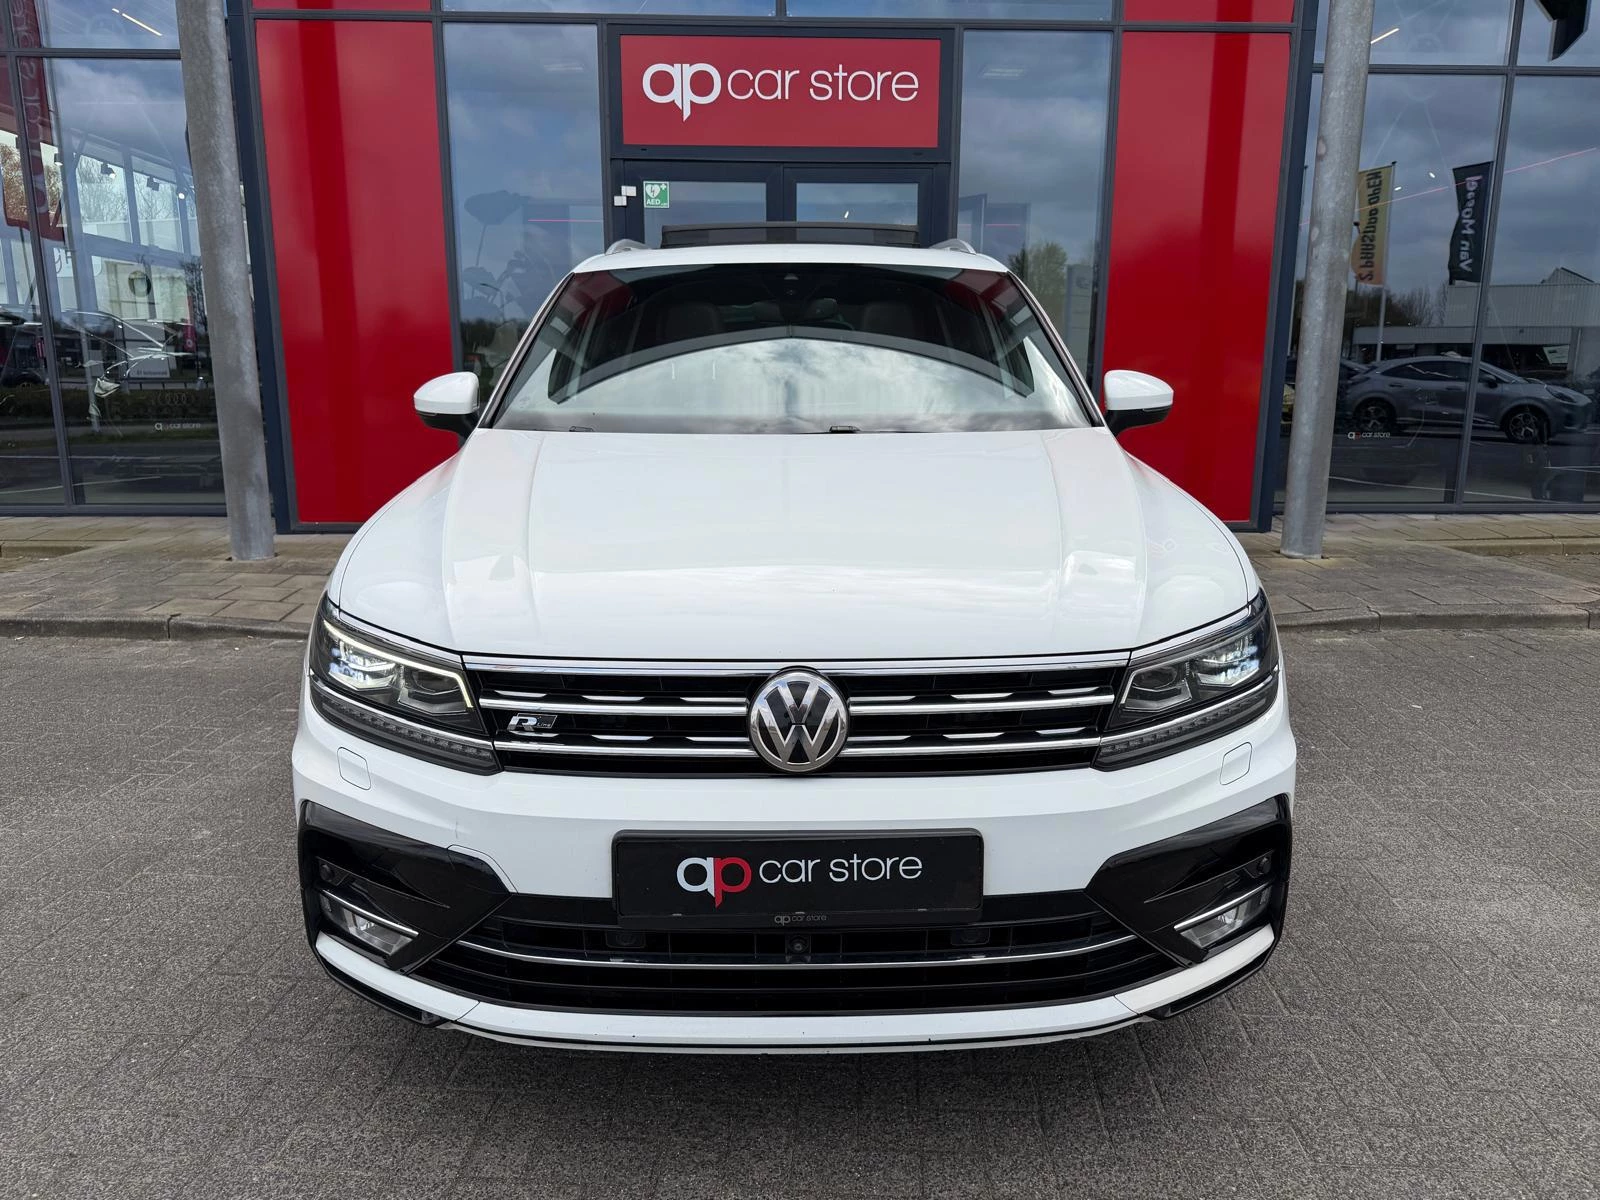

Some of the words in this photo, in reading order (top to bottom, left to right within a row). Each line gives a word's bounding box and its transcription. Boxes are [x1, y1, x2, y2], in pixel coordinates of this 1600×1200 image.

[642, 63, 722, 122] ap
[727, 69, 800, 100] car
[809, 63, 919, 102] store
[676, 857, 752, 908] ap
[759, 860, 820, 883] car
[829, 853, 922, 882] store
[774, 915, 791, 926] ap
